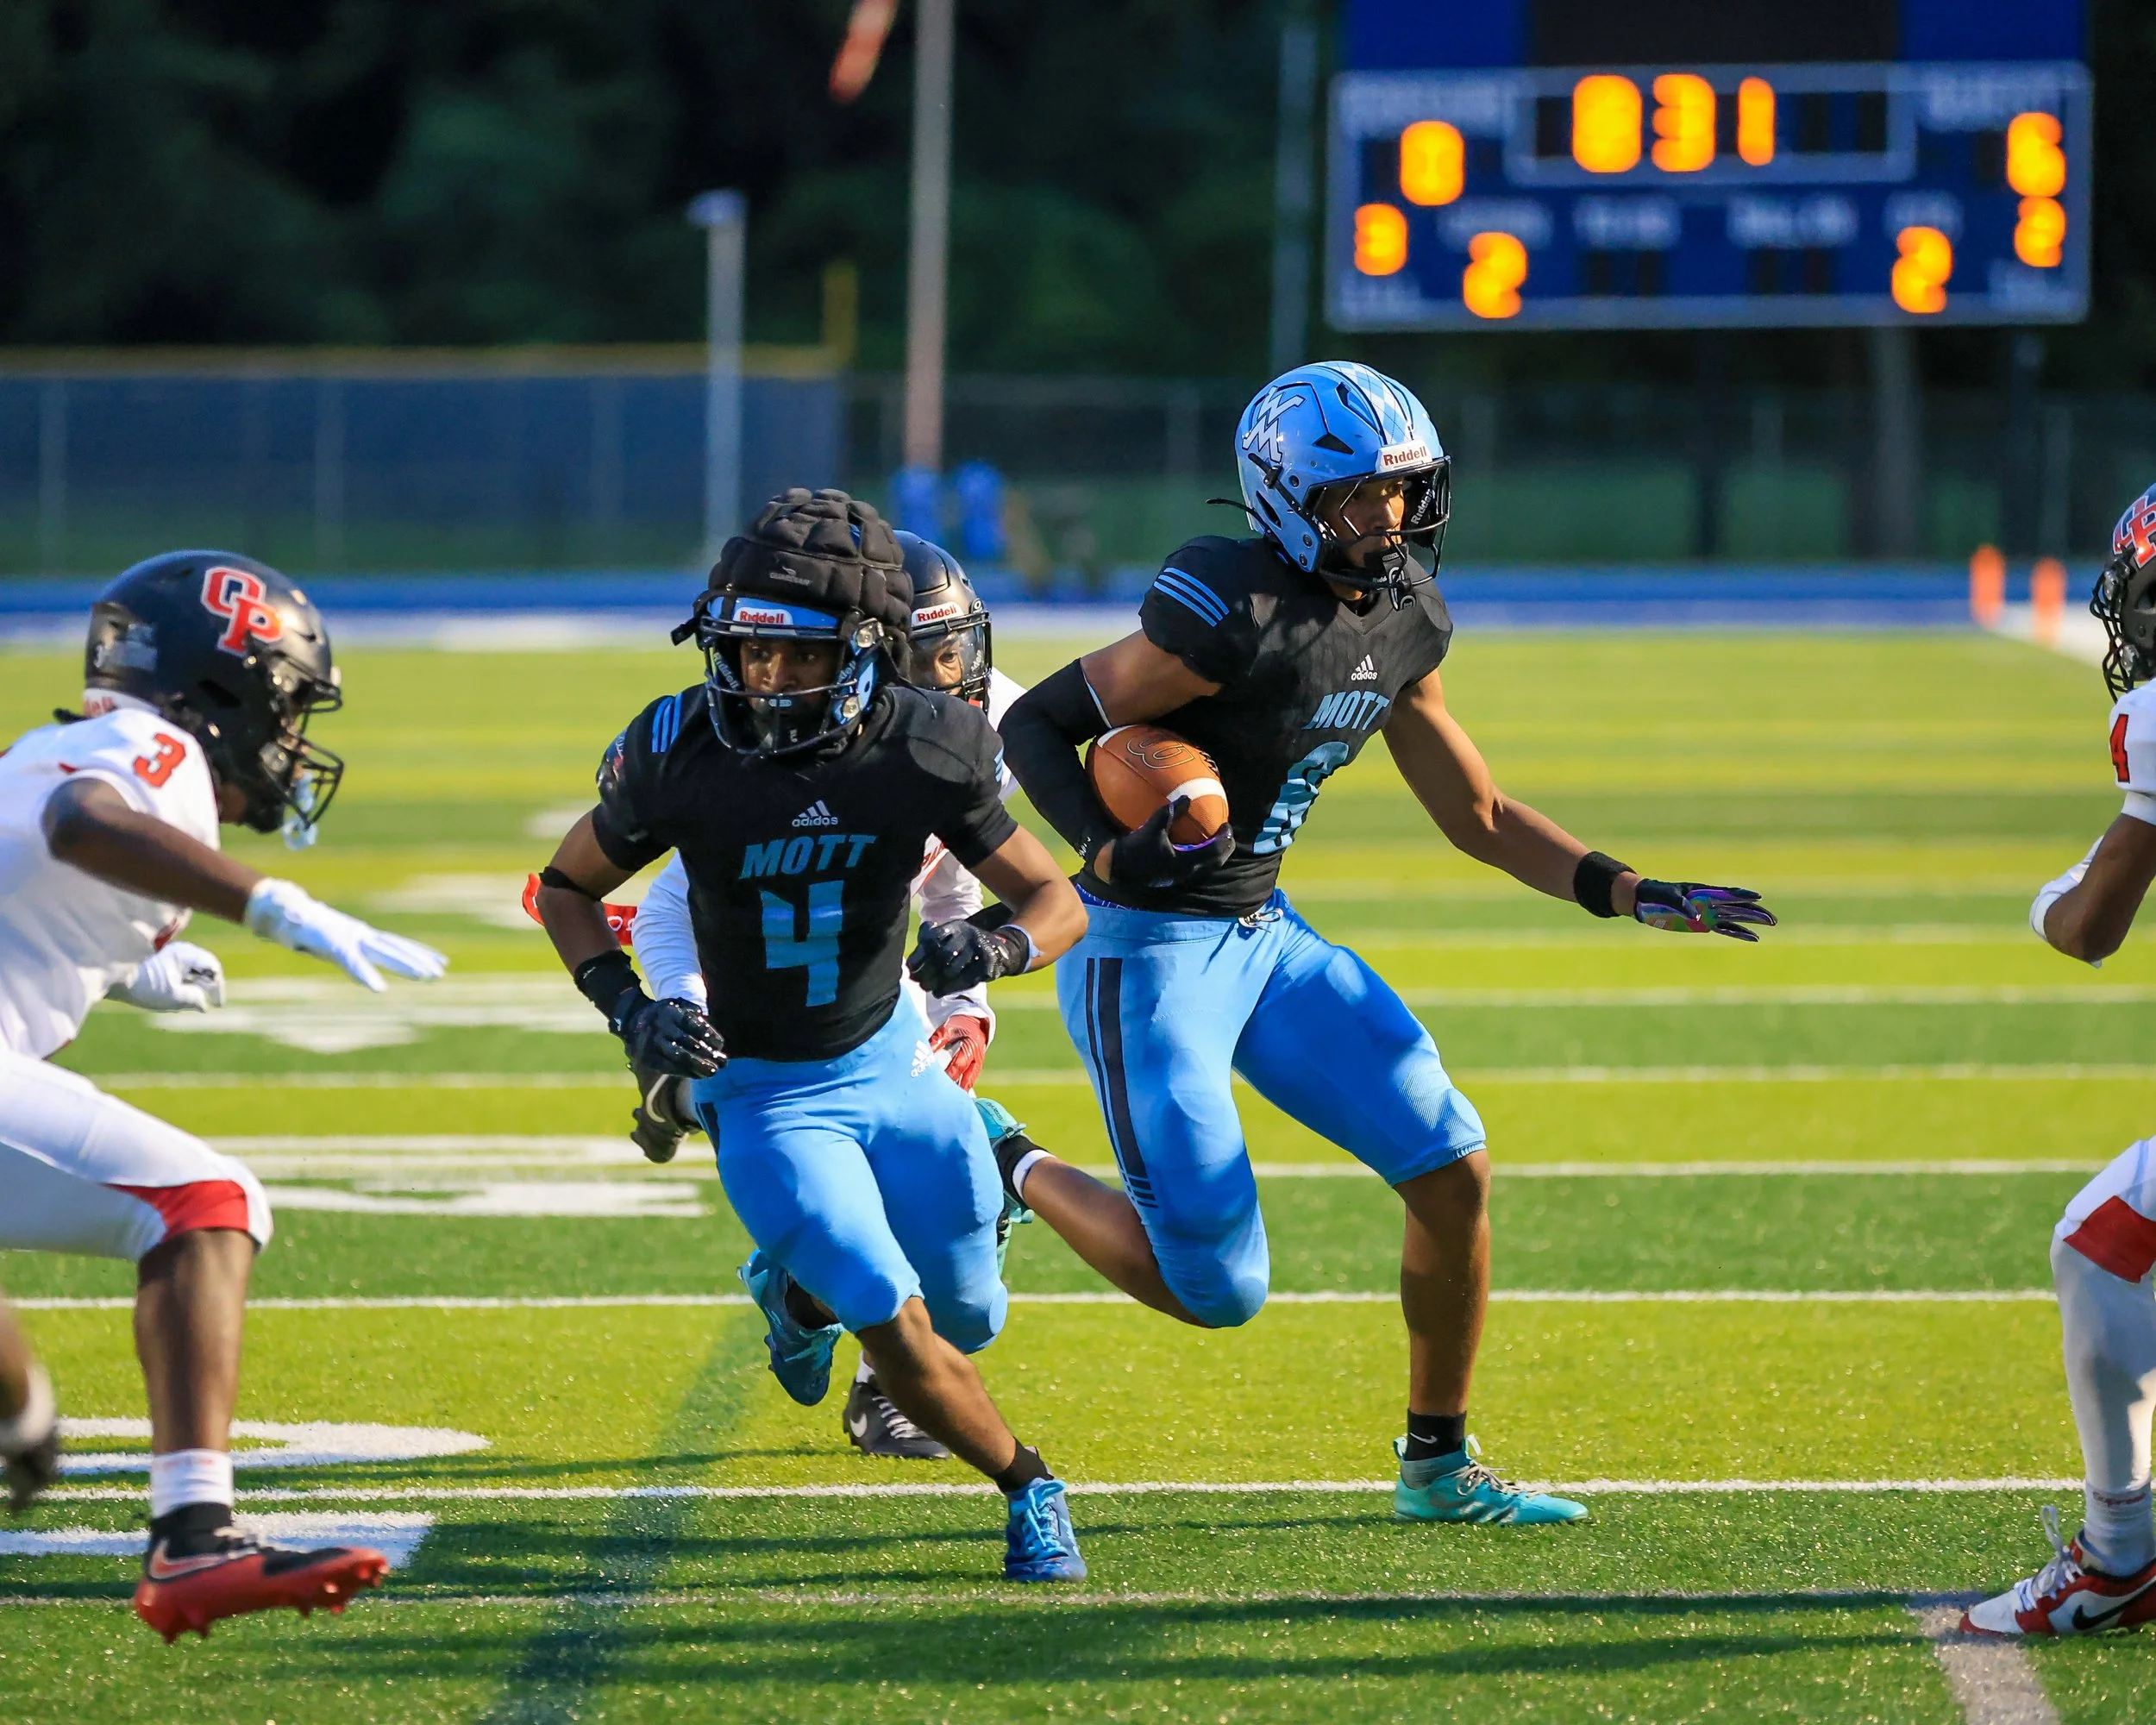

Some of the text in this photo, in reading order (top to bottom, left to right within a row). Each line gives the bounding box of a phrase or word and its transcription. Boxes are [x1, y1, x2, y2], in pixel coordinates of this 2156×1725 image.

[1400, 121, 1464, 206] 0
[2007, 112, 2065, 198] 6
[1463, 233, 1526, 318] 2
[1892, 227, 1952, 313] 2
[1382, 446, 1427, 466] Riddell
[201, 567, 283, 658] OP
[739, 610, 784, 624] Riddell
[917, 605, 957, 622] Riddell
[713, 652, 740, 689] Riddell
[1351, 669, 1378, 681] adidas
[1301, 690, 1390, 731] MOTT
[133, 733, 186, 787] 3
[792, 816, 839, 827] adidas
[738, 834, 878, 880] MOTT
[758, 880, 845, 1007] 4
